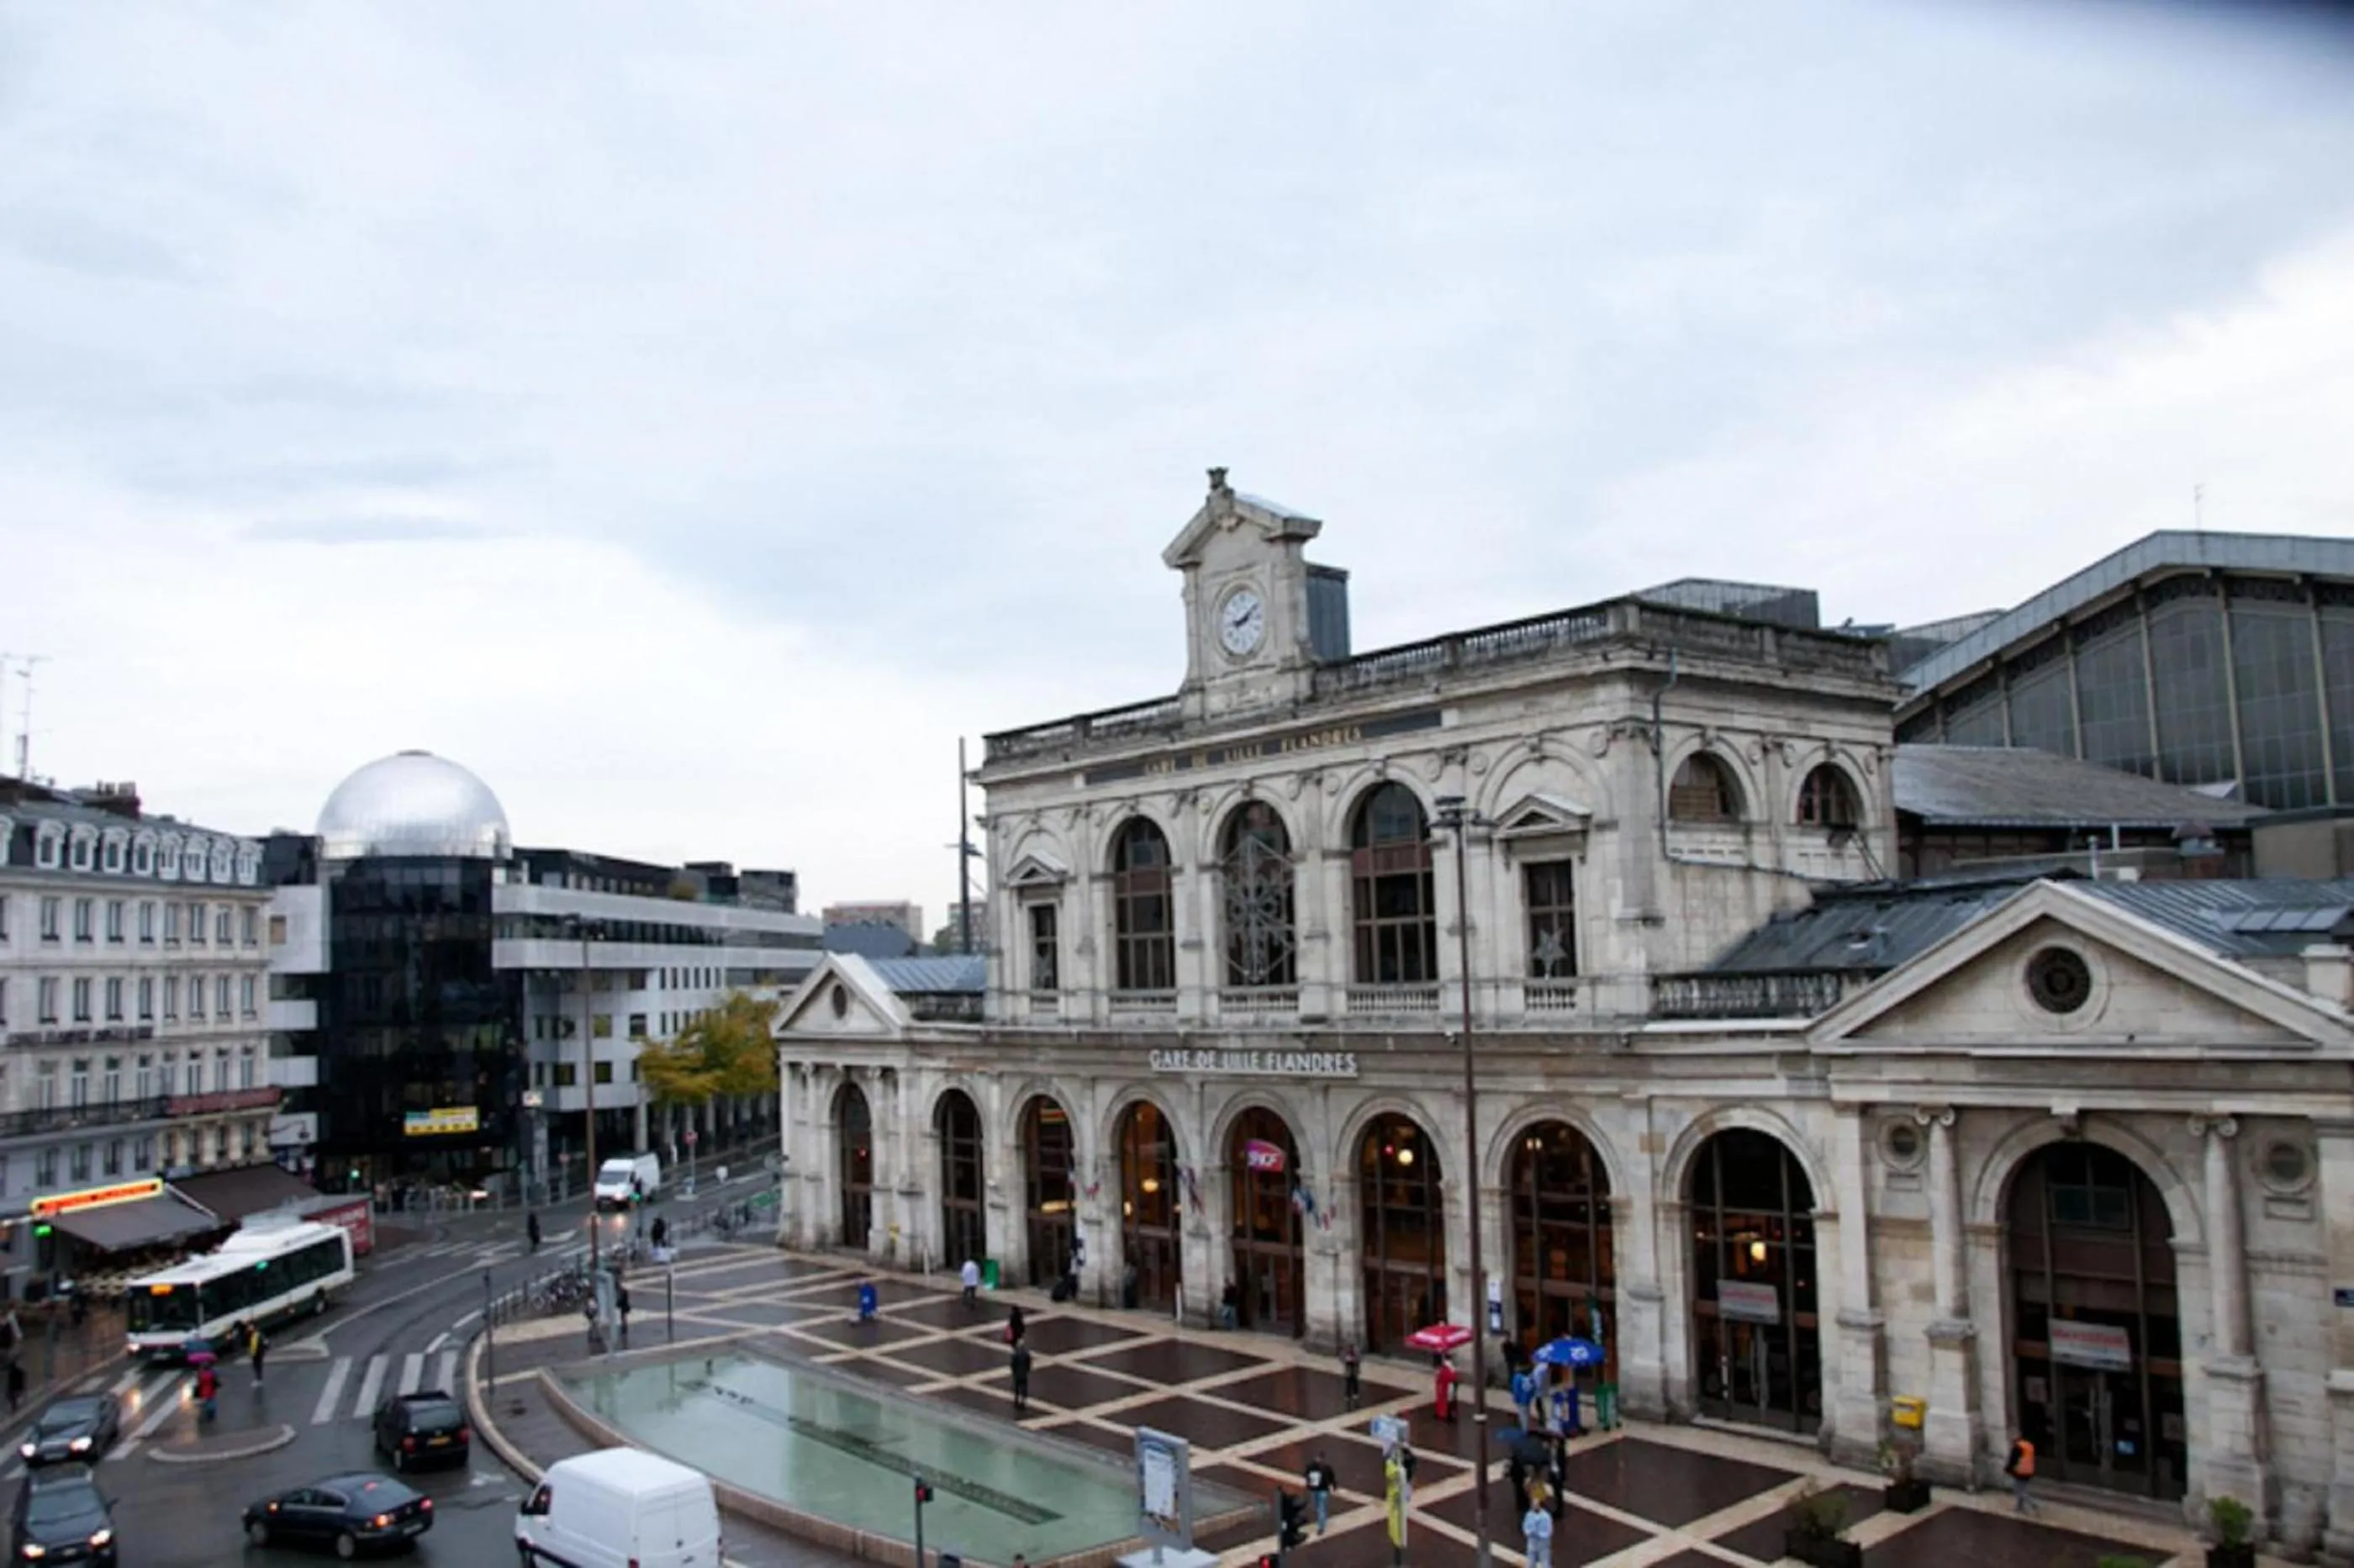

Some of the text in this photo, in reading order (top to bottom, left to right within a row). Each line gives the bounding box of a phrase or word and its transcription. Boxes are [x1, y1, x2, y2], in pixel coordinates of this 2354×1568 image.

[1149, 1049, 1358, 1074] GARE DE LILLE FLANDRES
